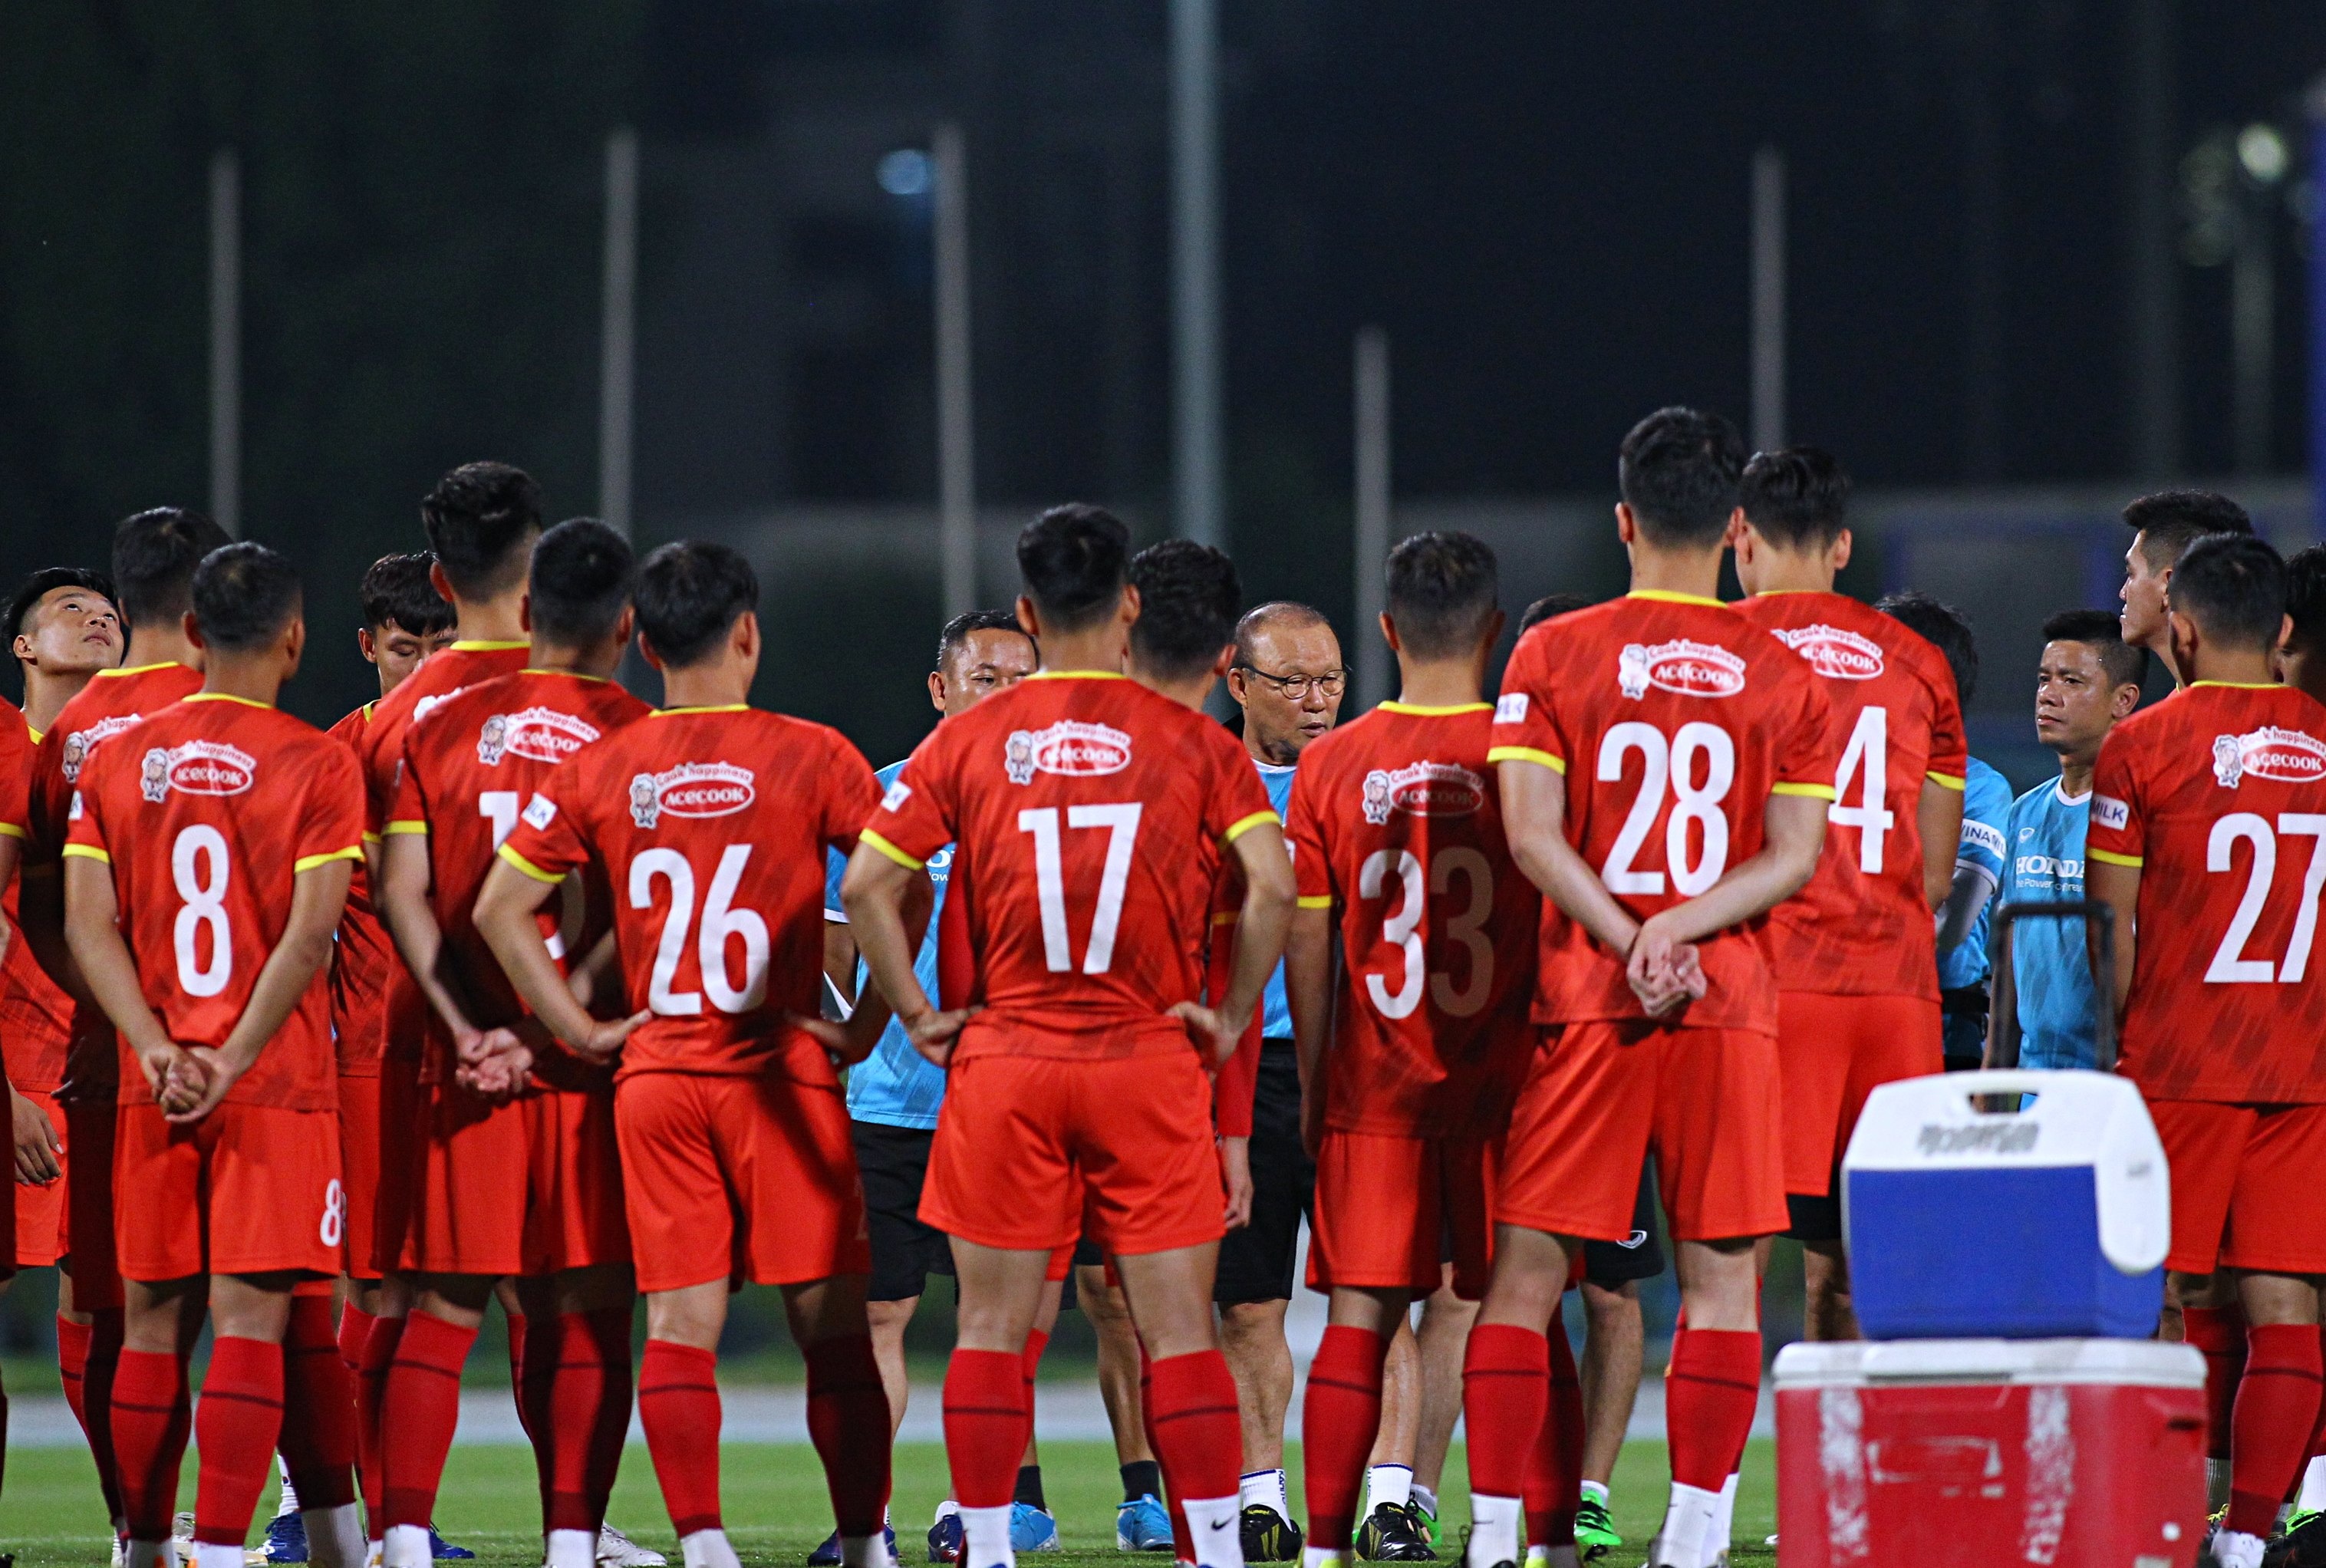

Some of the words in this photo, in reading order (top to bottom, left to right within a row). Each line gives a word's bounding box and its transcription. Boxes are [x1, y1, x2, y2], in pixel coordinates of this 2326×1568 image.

[1598, 722, 1735, 898] 28
[1828, 706, 1894, 873] 4
[172, 824, 232, 997] 8
[628, 843, 770, 1016] 26
[1017, 802, 1142, 974] 17
[1359, 847, 1494, 1020] 33
[2203, 812, 2326, 983] 27
[320, 1178, 341, 1247] 8
